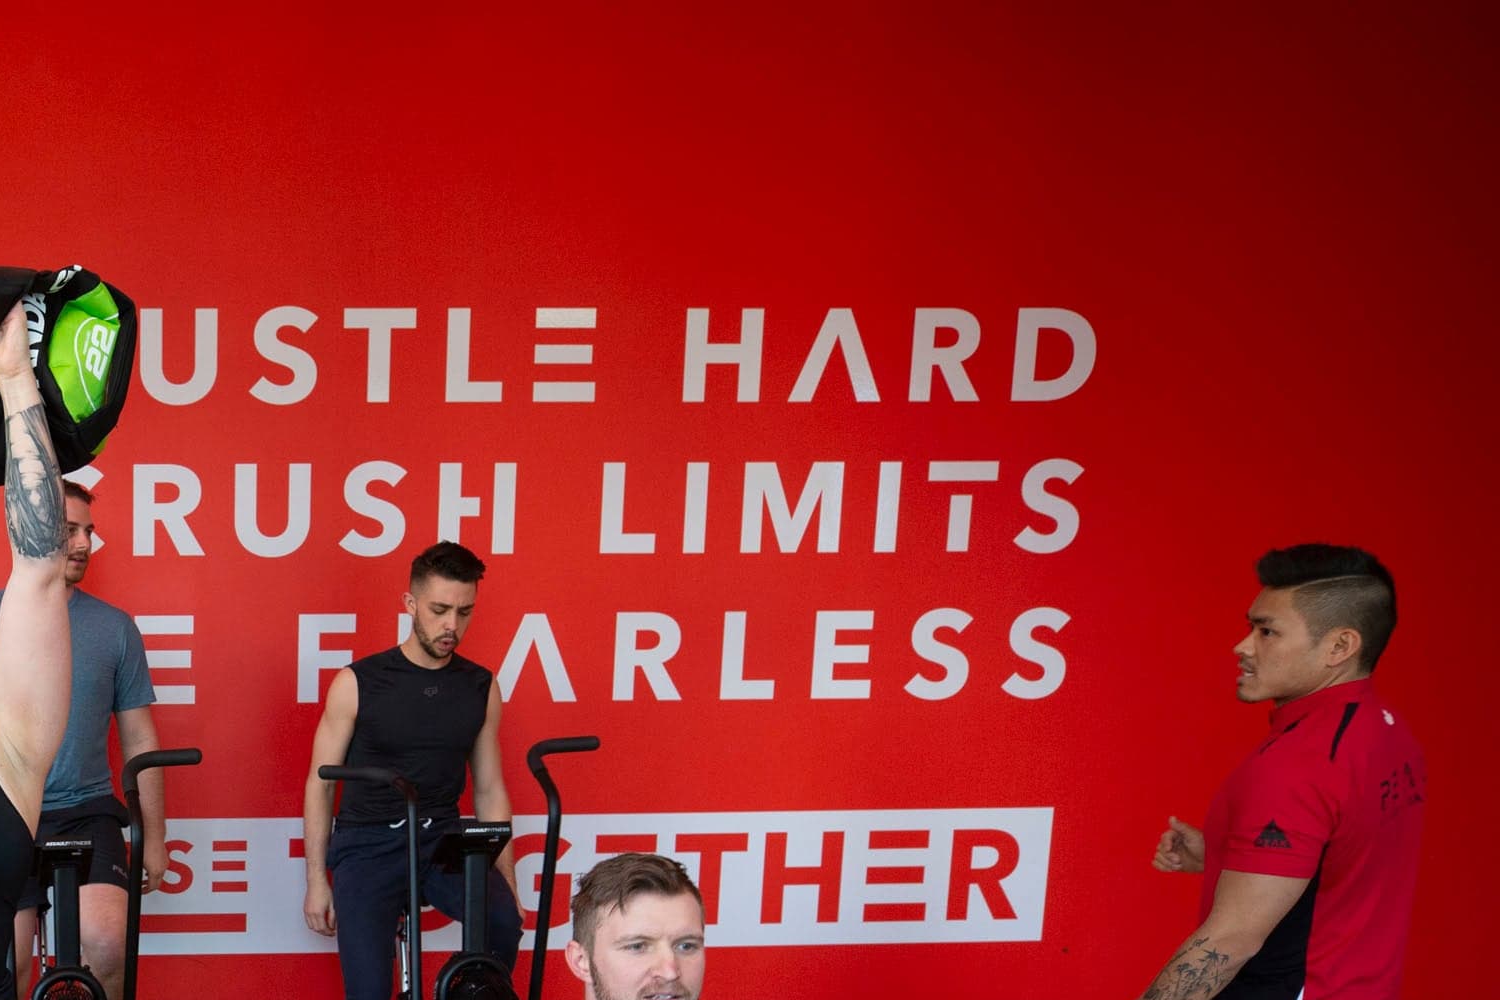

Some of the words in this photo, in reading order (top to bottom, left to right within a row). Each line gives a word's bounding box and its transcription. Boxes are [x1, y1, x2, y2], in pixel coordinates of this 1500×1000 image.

[139, 306, 597, 406] USTLE
[682, 307, 1098, 403] HARD
[62, 460, 518, 558] RUSH
[599, 458, 1086, 555] LIMITS
[134, 615, 195, 704] E
[297, 606, 1072, 704] FARLESS
[289, 827, 1019, 932] GTHER
